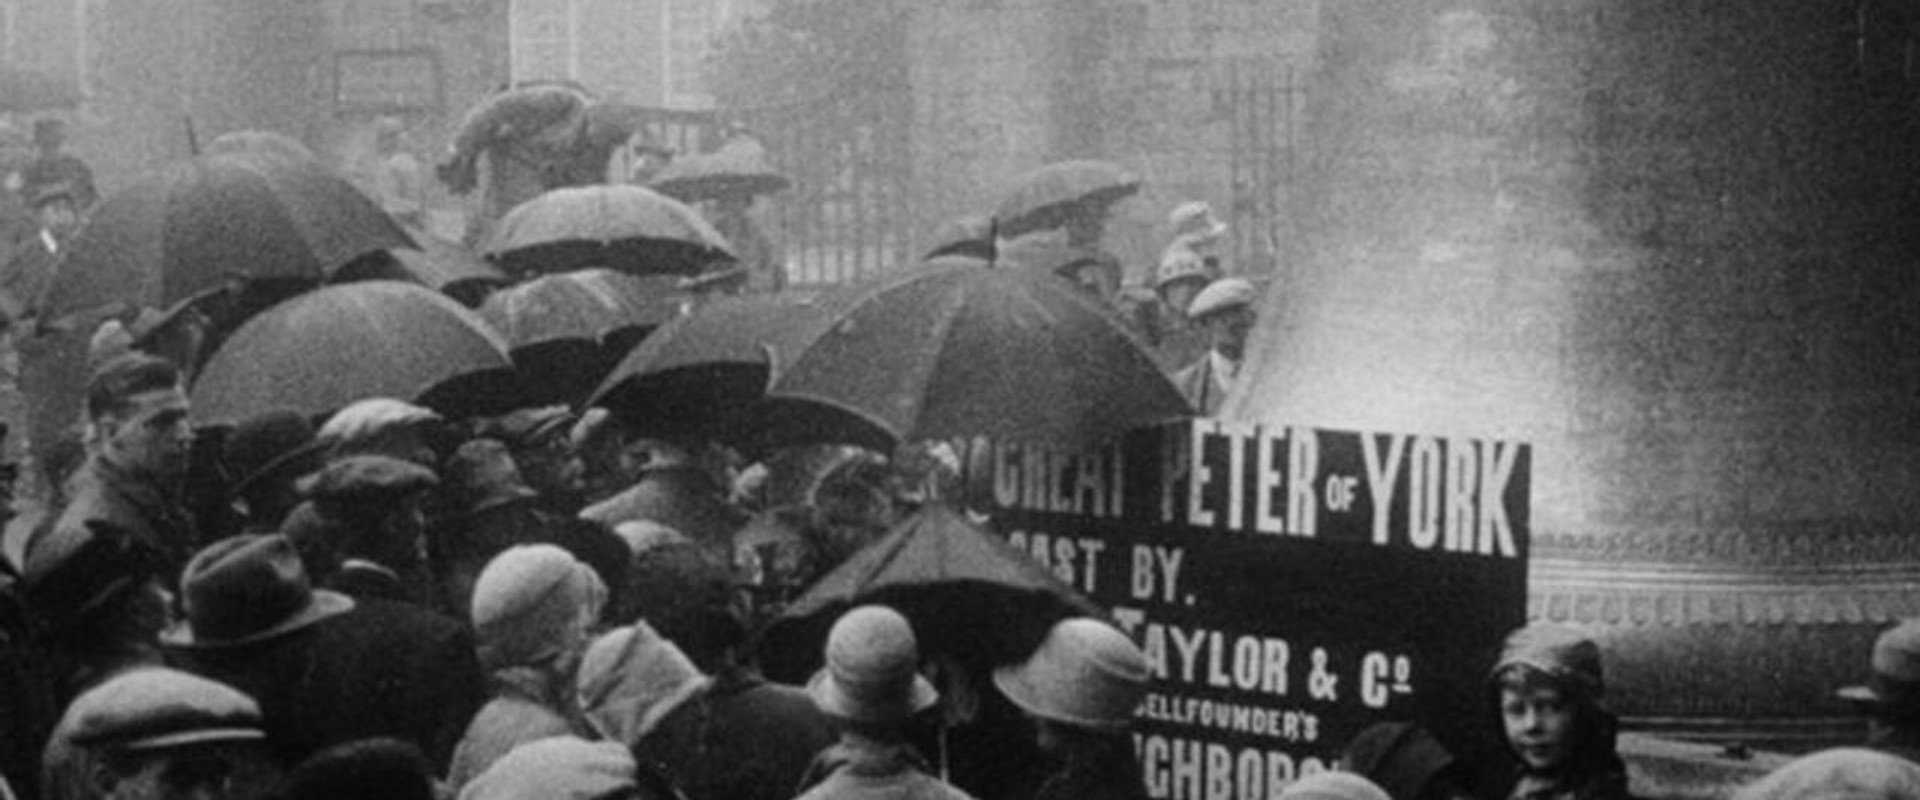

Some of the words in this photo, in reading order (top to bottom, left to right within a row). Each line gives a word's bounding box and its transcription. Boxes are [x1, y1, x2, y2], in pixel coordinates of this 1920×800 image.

[1160, 416, 1319, 537] PETER
[1326, 473, 1358, 512] OF
[1360, 428, 1517, 558] YORK
[1009, 531, 1106, 593] AST
[1132, 544, 1196, 606] BY.
[1308, 647, 1338, 700] &
[1134, 693, 1320, 742] ELLFOUNDER'S
